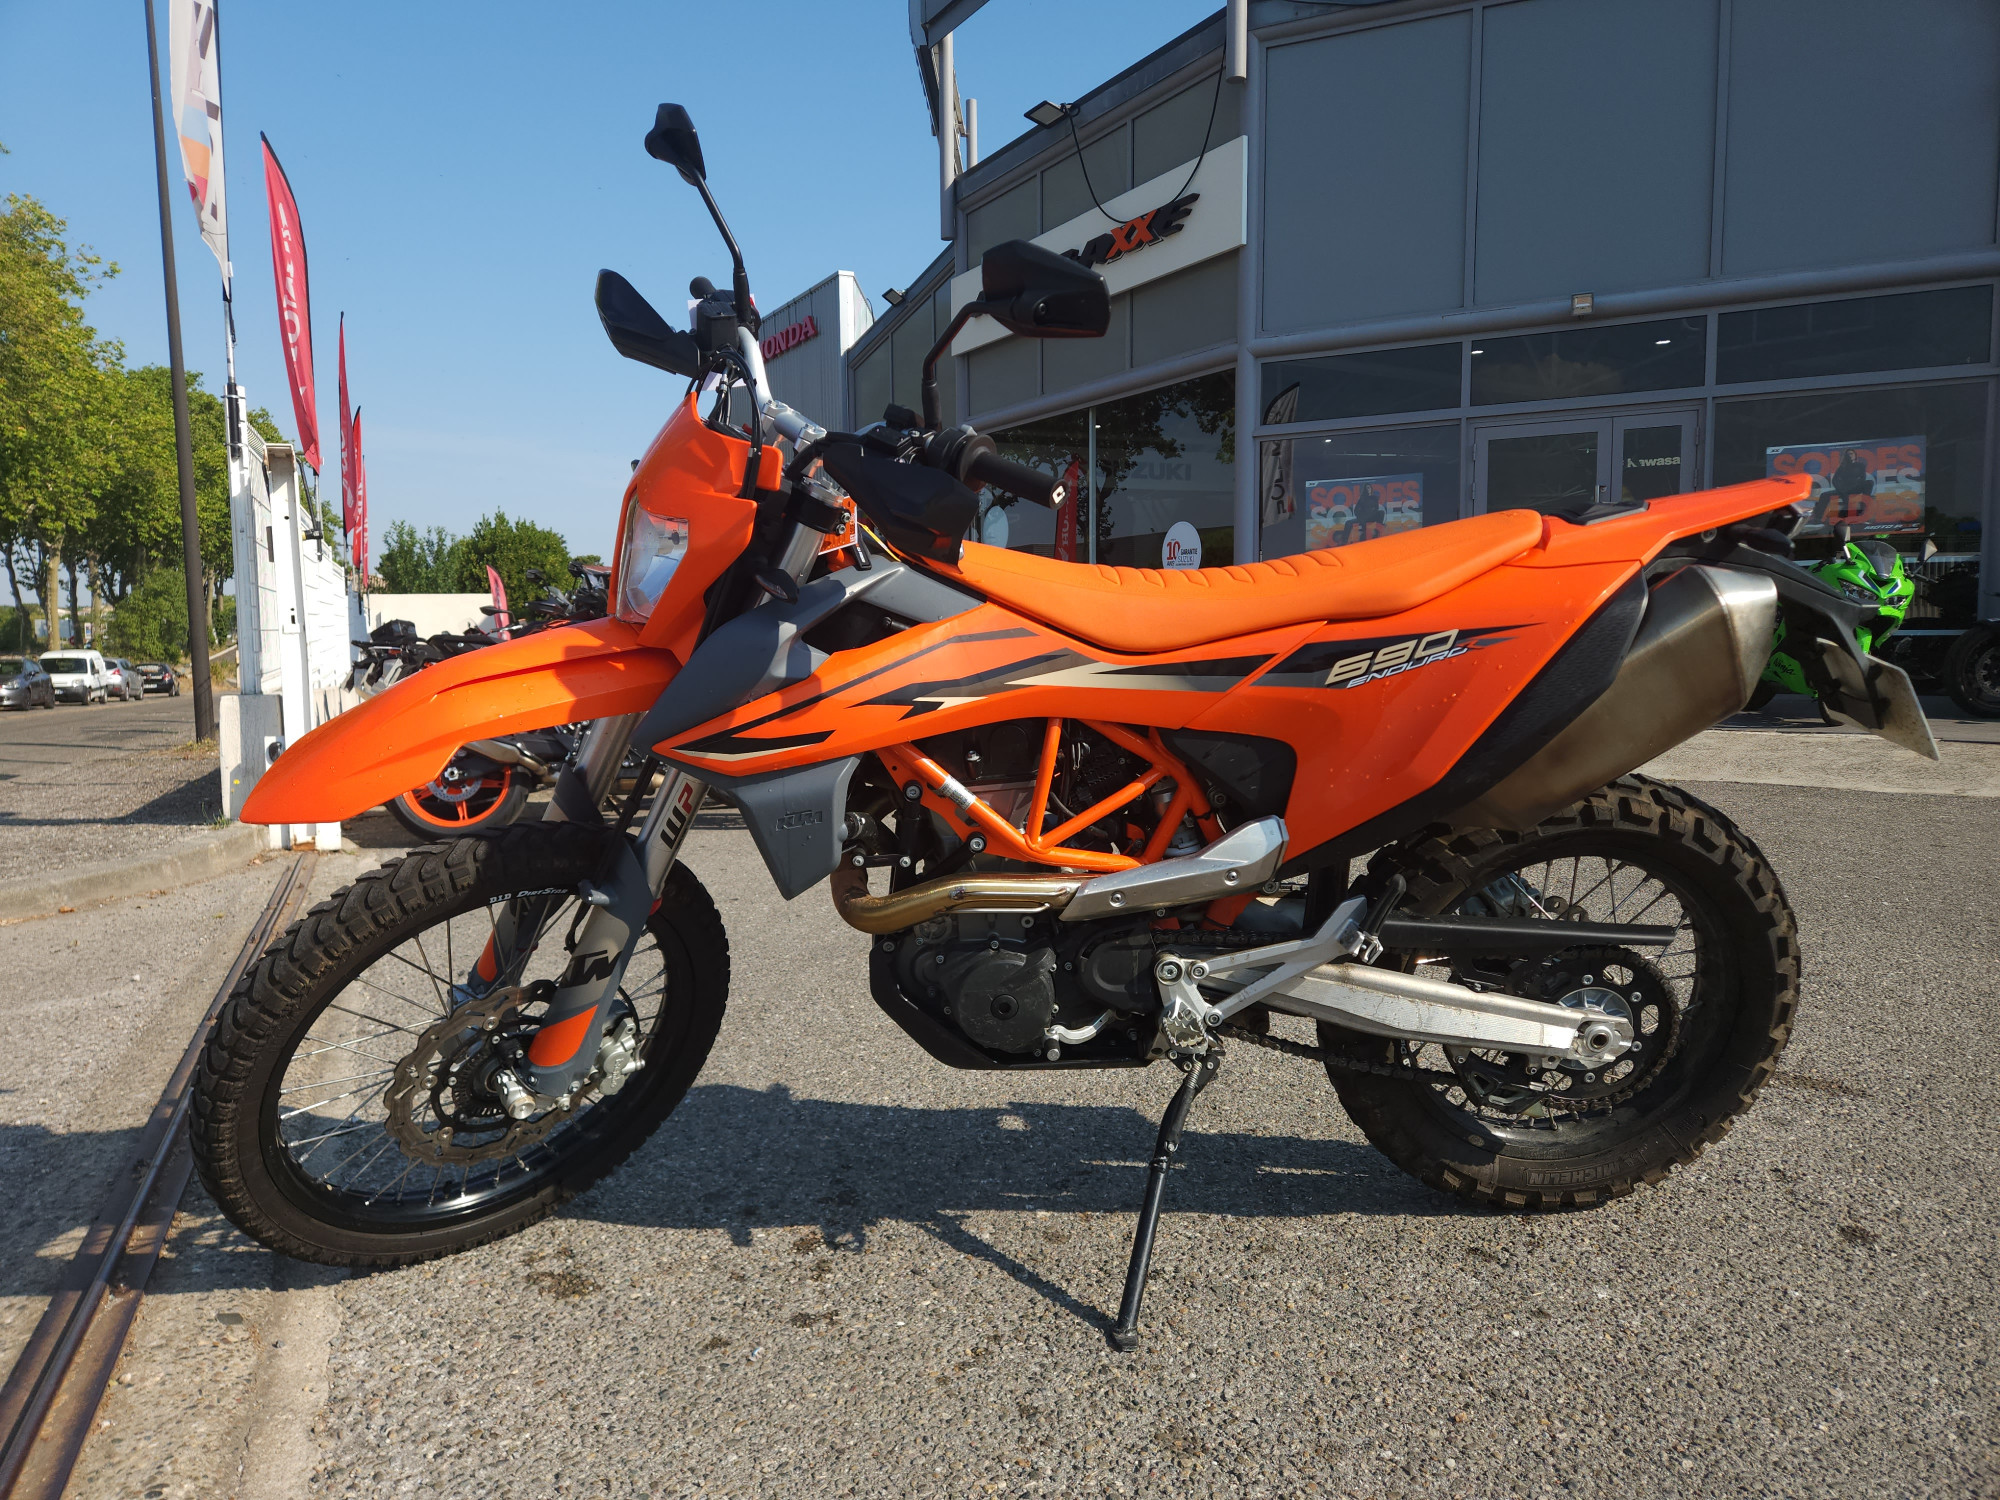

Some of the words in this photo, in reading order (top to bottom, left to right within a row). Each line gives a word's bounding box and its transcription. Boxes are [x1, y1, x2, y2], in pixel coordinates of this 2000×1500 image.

[760, 315, 818, 364] ONDA
[1132, 462, 1192, 481] ZUKI
[1167, 541, 1181, 560] 10
[1325, 629, 1460, 685] 690
[1346, 647, 1468, 689] ENDURO
[1773, 658, 1796, 675] Ninja
[1529, 1161, 1622, 1185] MICHELIN
